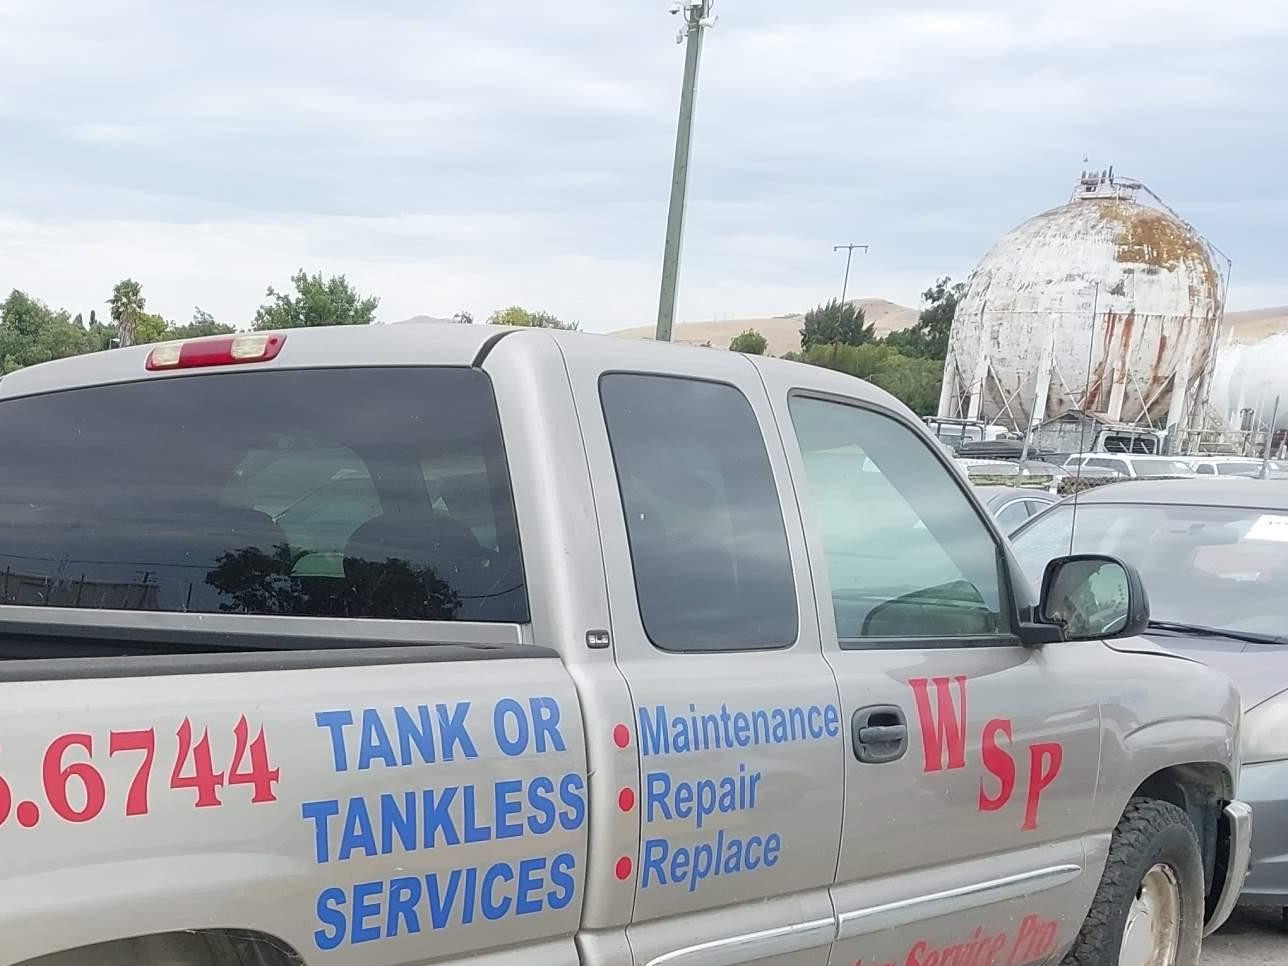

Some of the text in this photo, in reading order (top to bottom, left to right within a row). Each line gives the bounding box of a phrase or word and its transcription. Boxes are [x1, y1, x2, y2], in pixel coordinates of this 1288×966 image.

[315, 696, 567, 772] TANK OR
[639, 703, 840, 757] Maintenance
[909, 675, 1063, 831] WSP
[302, 773, 587, 865] TANKLESS
[646, 764, 760, 828] Repair
[641, 830, 781, 892] Replace
[314, 853, 576, 951] SERVICES
